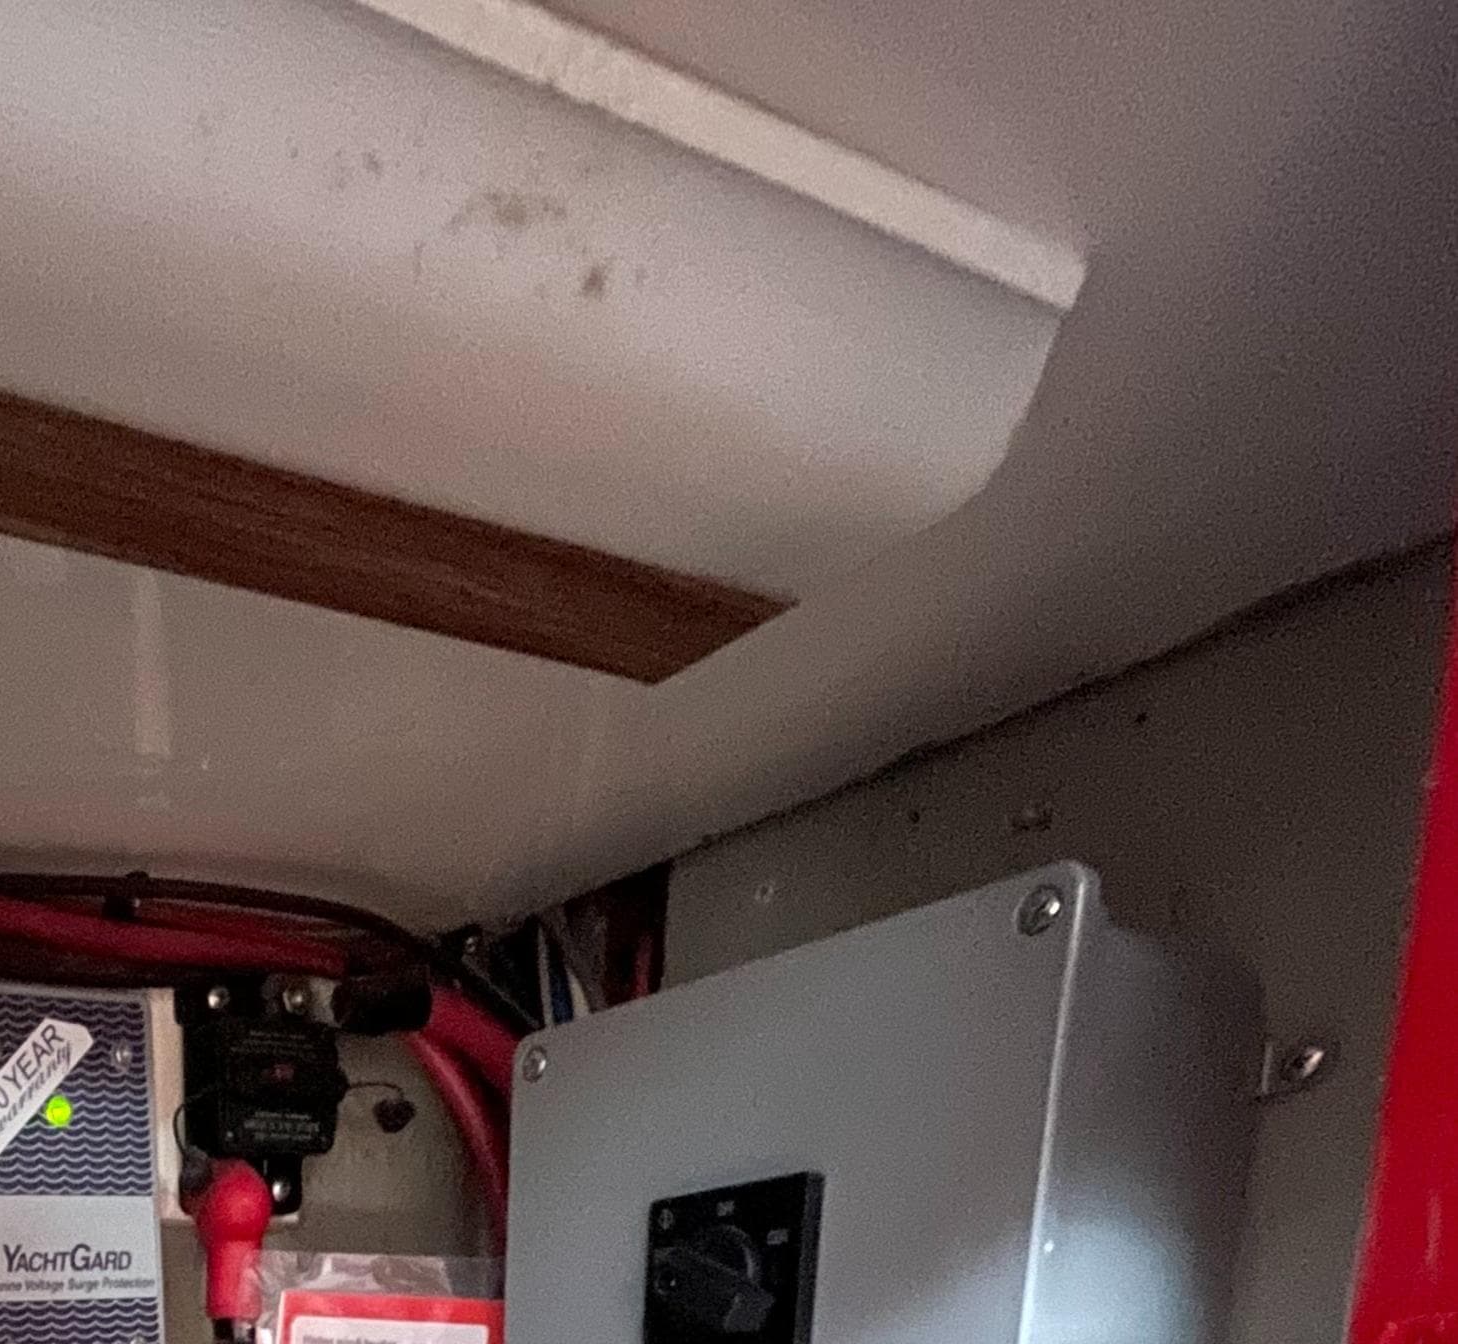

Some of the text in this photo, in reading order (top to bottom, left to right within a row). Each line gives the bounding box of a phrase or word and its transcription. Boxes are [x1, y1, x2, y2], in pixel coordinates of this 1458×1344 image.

[2, 1023, 65, 1089] YEAR
[25, 1279, 65, 1294] Voltage
[68, 1278, 101, 1293] Surge
[102, 1276, 155, 1291] Protection
